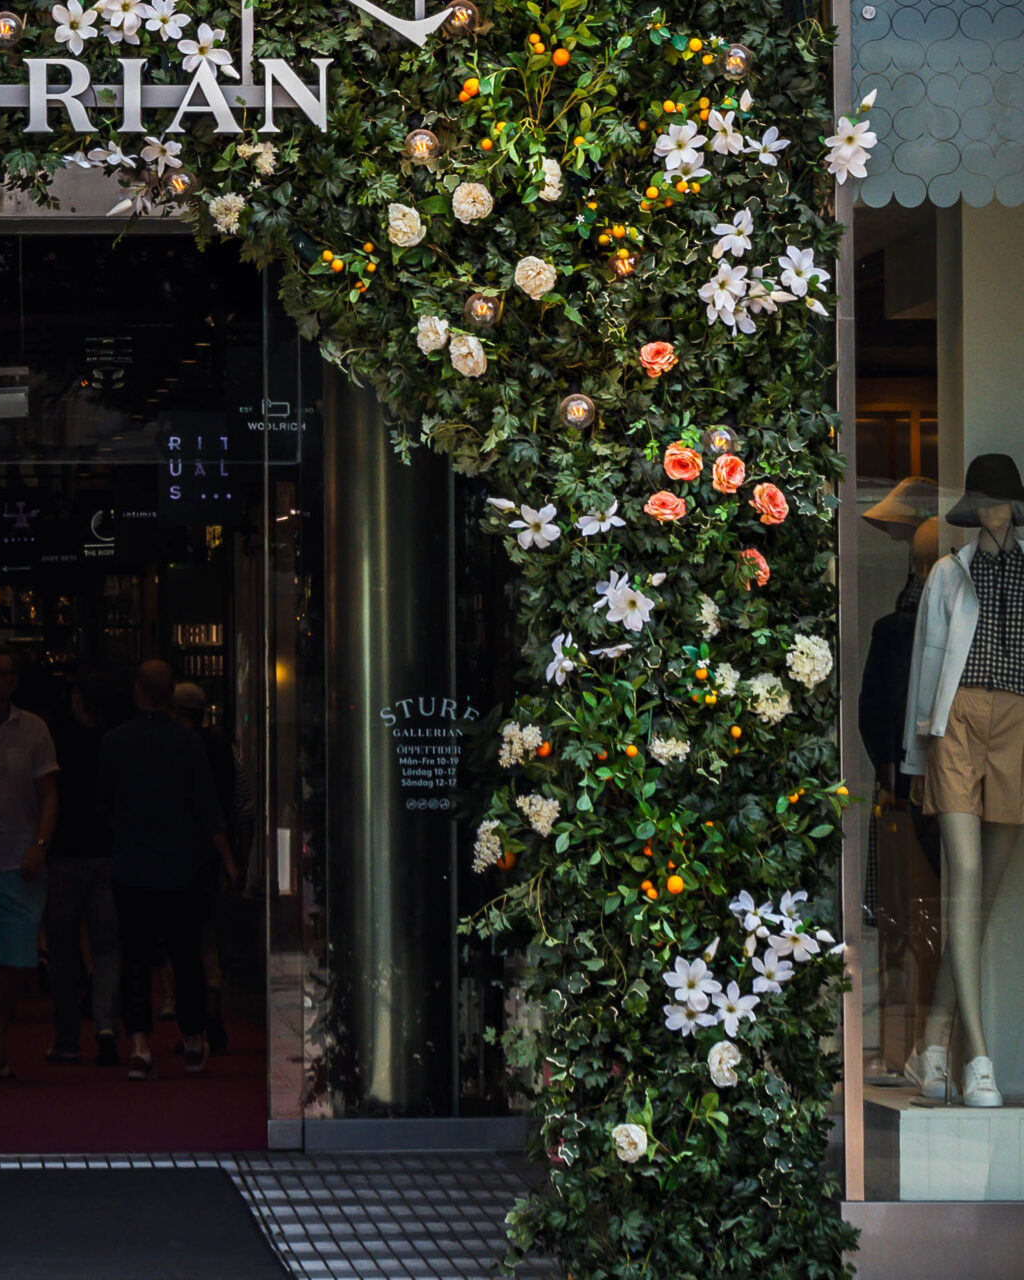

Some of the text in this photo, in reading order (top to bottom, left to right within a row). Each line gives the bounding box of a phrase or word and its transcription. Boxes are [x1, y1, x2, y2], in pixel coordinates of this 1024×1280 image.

[392, 728, 464, 737] GALLERIAN
[402, 768, 456, 777] Lördag 10-17
[401, 778, 457, 789] Söndag 12-17
